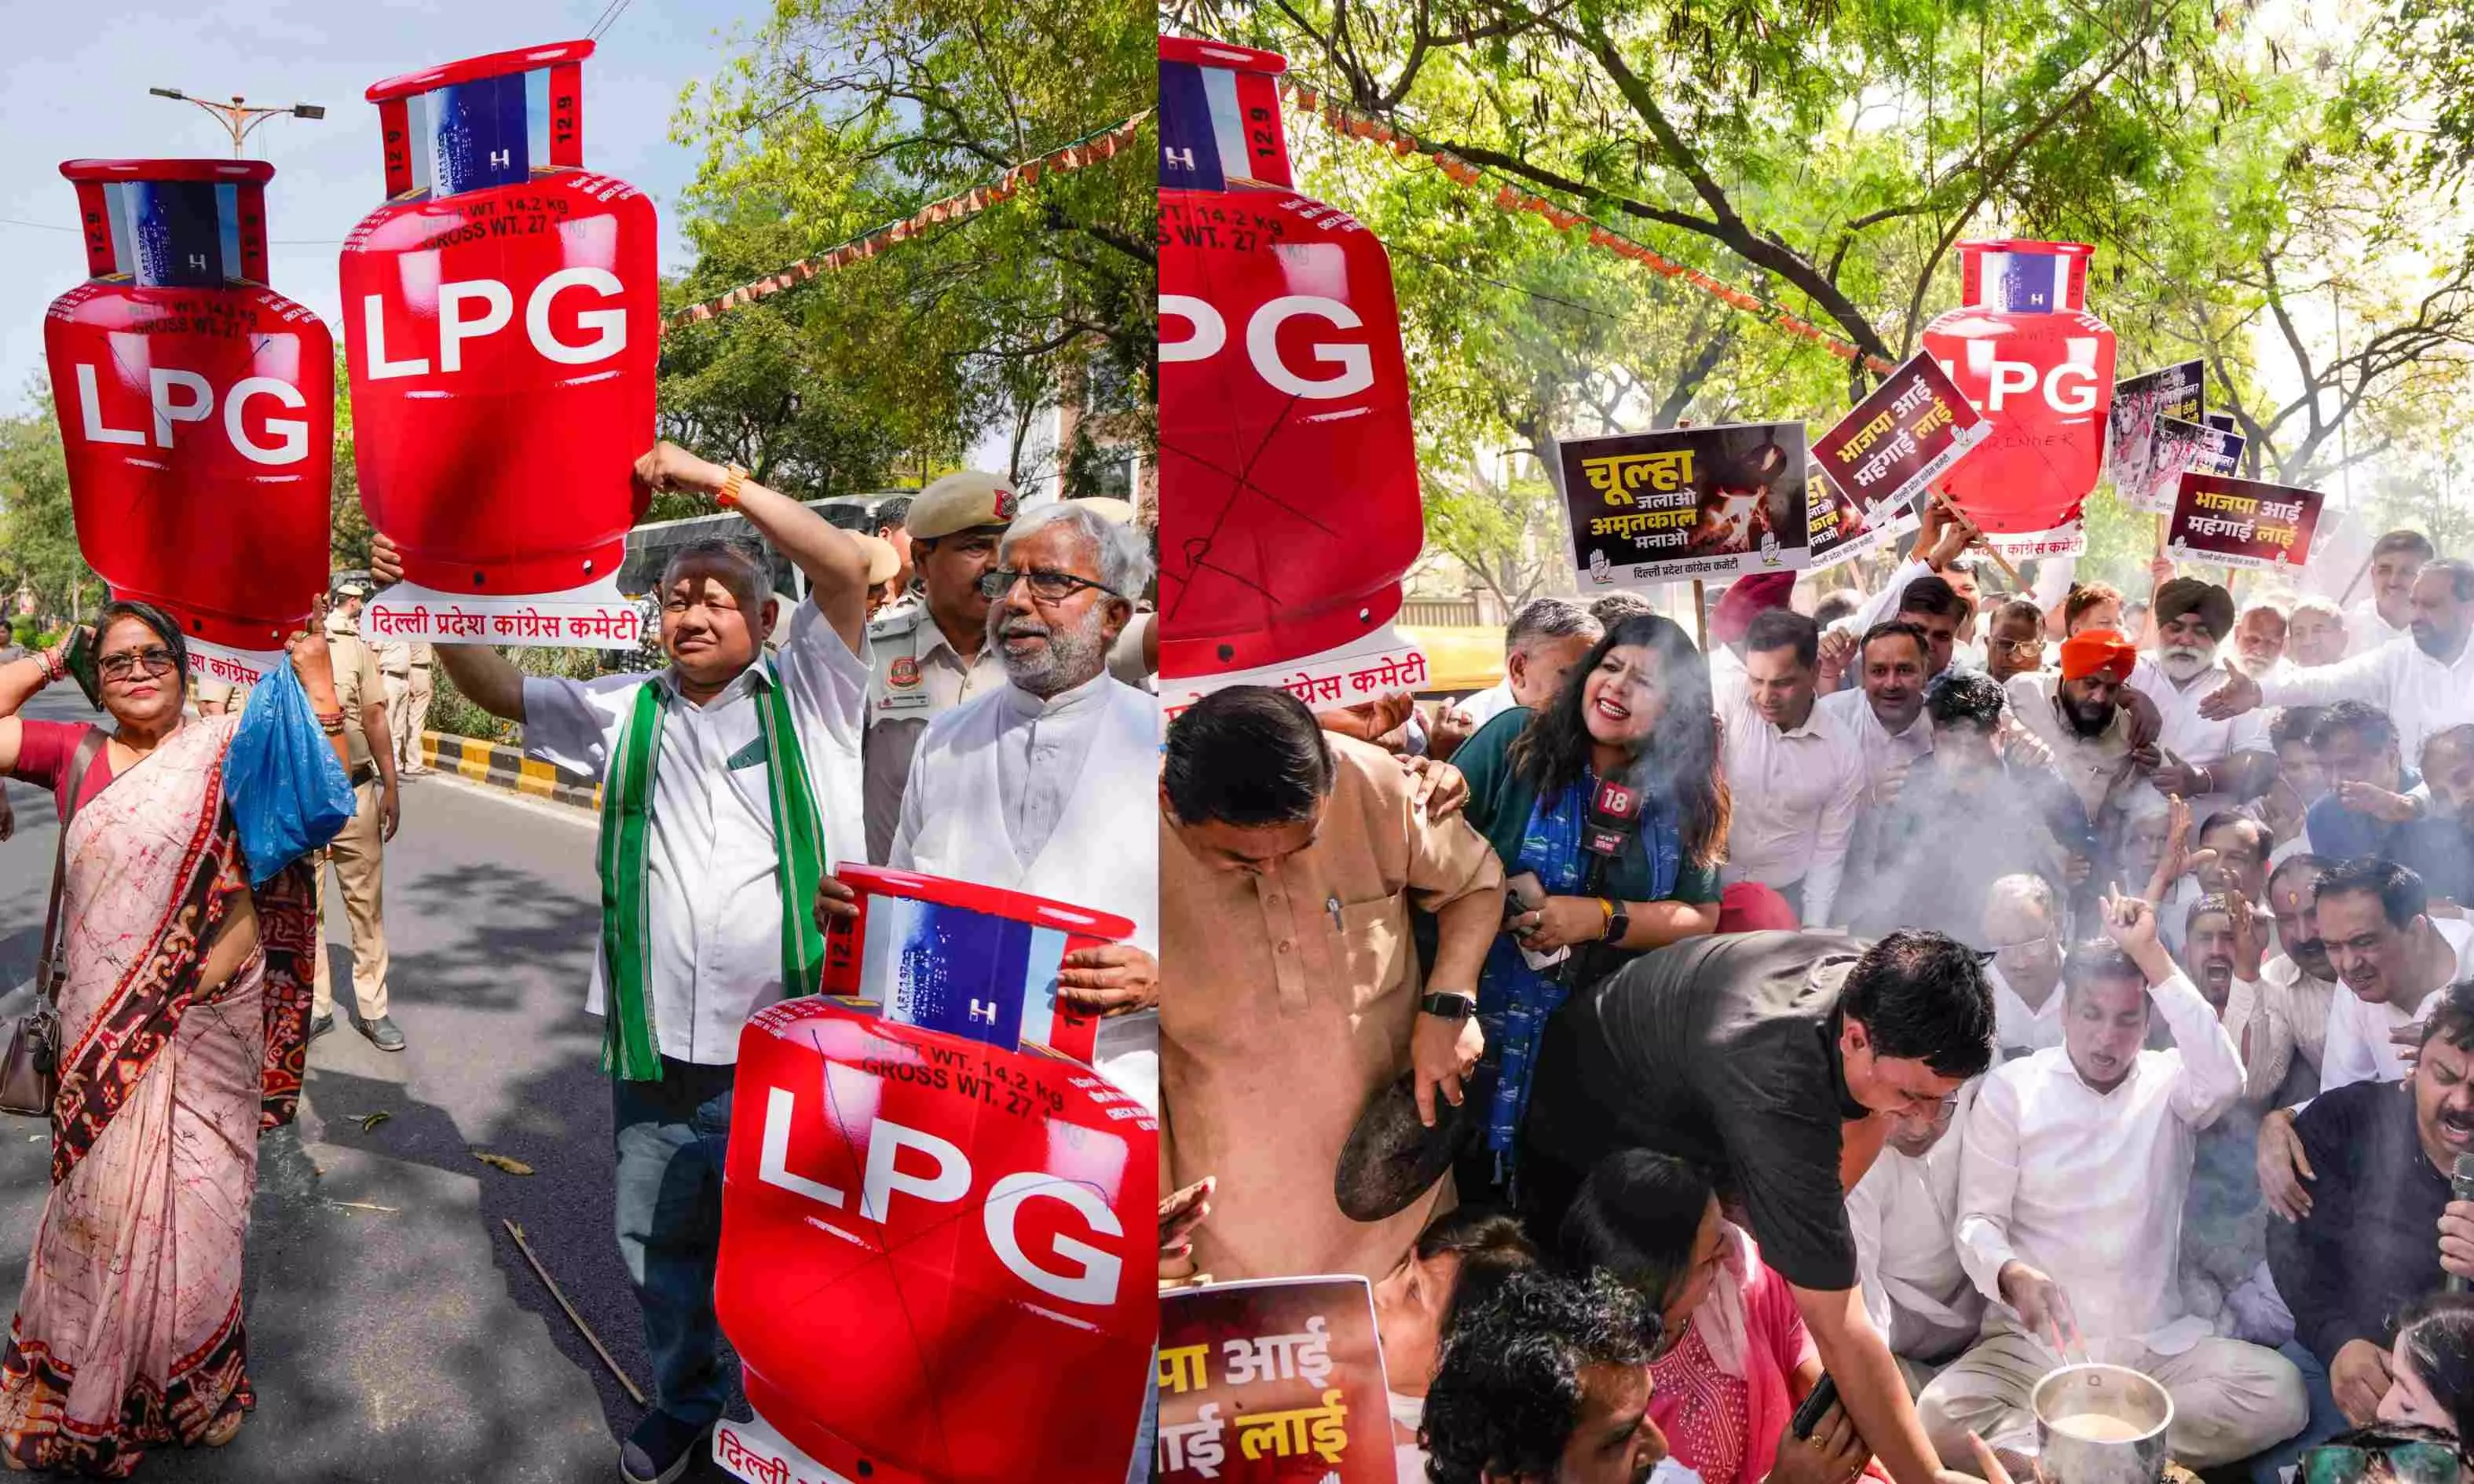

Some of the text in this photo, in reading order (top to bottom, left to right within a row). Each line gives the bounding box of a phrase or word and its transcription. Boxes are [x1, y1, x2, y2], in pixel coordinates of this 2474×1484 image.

[556, 95, 573, 143] 12.9
[1249, 106, 1275, 159] 12.9
[490, 216, 524, 237] WT.
[1177, 225, 1226, 249] WT.
[364, 265, 628, 381] LPG
[75, 363, 309, 466] LPG
[1836, 375, 1933, 463] भाजपा आई
[1854, 396, 1954, 488] महंगाई लाई
[1581, 449, 1696, 506] चूल्हा
[1636, 487, 1696, 510] जलाओ
[1590, 509, 1697, 539] अमृतकाल
[2195, 490, 2304, 525] भाजपा आई
[1634, 528, 1689, 550] मनाओ
[2007, 539, 2044, 556] कांग्रेस
[2049, 537, 2083, 554] कमेटी
[2187, 514, 2298, 550] महंगाई लाई
[1634, 565, 1660, 579] दिल्ली
[371, 605, 639, 641] दिल्ली प्रदेश कांग्रेस कमेटी
[1348, 652, 1427, 693] कमेटी
[1605, 788, 1628, 812] 18
[862, 1056, 949, 1091] GROSS
[957, 1072, 998, 1106] WT.
[931, 1046, 973, 1072] WT.
[982, 1060, 1030, 1091] 14.2
[1035, 1080, 1064, 1112] kg
[758, 1086, 1125, 1306] LPG
[1222, 1315, 1333, 1389] आई
[1234, 1388, 1349, 1464] लाई
[718, 1428, 791, 1484] दिल्ली
